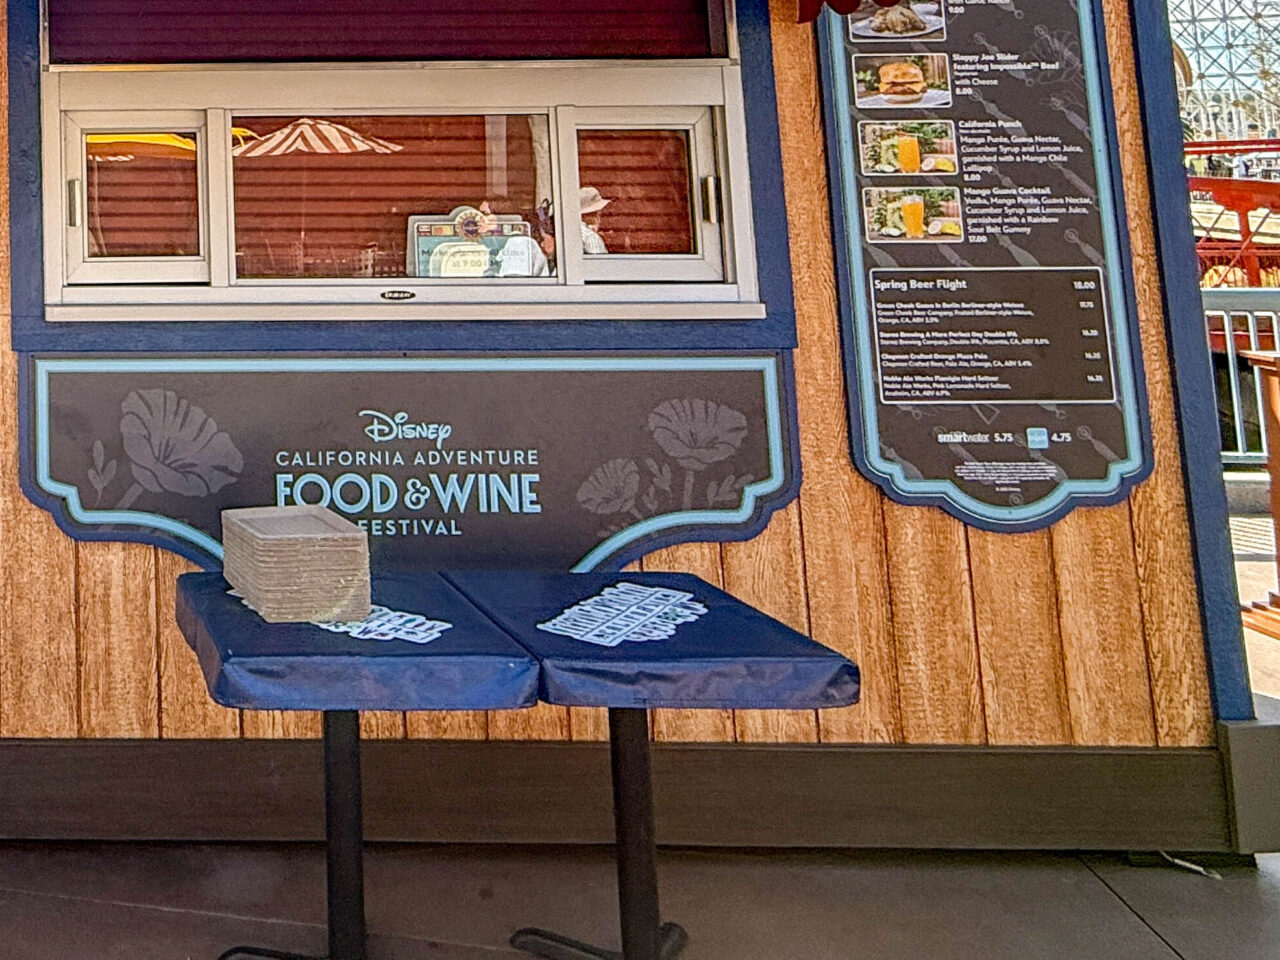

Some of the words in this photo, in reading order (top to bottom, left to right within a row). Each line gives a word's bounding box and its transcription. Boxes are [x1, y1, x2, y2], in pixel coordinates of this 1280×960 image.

[964, 188, 991, 196] Mango
[1003, 226, 1031, 235] Gummy
[875, 280, 907, 291] Spring
[910, 280, 934, 289] Beer
[937, 280, 967, 291] Flight
[358, 410, 452, 450] Disney
[994, 433, 1013, 442] 5.75
[1051, 433, 1072, 442] 4.75
[275, 450, 405, 466] CALIFORNIA
[413, 449, 539, 465] ADVENTURE
[276, 473, 398, 514] FOOD
[404, 478, 431, 511] &
[428, 473, 542, 514] WINE
